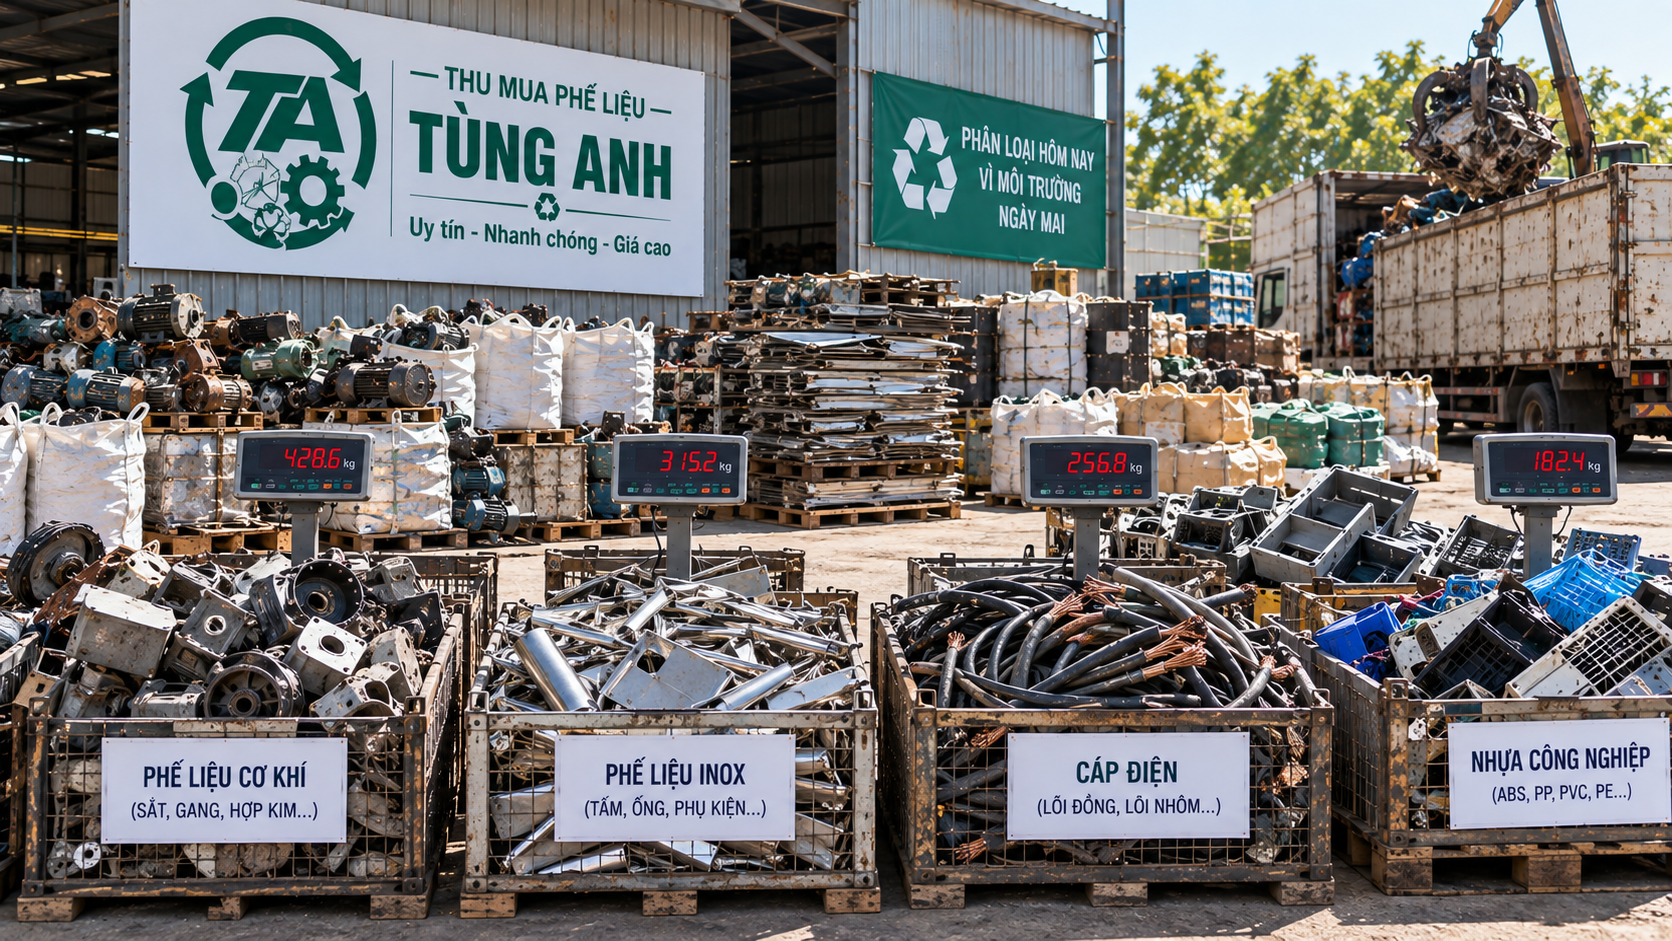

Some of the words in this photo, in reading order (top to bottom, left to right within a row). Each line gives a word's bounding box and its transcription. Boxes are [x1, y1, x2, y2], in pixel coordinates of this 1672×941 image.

[444, 66, 491, 95] THU
[499, 75, 548, 104] MUA
[556, 83, 597, 112] PHẾ
[603, 90, 645, 122] LIỆU
[217, 68, 346, 155] TA
[409, 100, 556, 187] TÙNG
[572, 134, 671, 200] ANH
[962, 126, 1000, 155] PHÂN
[1006, 135, 1034, 164] LOẠI
[1040, 139, 1067, 167] HÔM
[1072, 148, 1094, 171] NAY
[979, 163, 992, 190] VÌ
[998, 167, 1023, 195] MÔI
[1028, 174, 1080, 203] TRƯỜNG
[1000, 203, 1036, 230] NGÀY
[1041, 211, 1064, 234] MAI
[410, 216, 434, 242] Uy
[440, 219, 464, 240] tín
[485, 223, 541, 246] Nhanh
[546, 229, 597, 255] chóng
[614, 235, 639, 254] Giá
[644, 242, 671, 256] cao
[285, 448, 341, 468] 428.6
[343, 458, 356, 471] kg
[660, 451, 717, 472] 315.2
[719, 461, 732, 474] kg
[1068, 452, 1126, 473] 256.8
[1129, 462, 1143, 475] kg
[1535, 451, 1584, 471] 182.4
[1587, 461, 1601, 474] kg
[606, 756, 645, 785] PHẾ
[651, 758, 692, 790] LIỆU
[700, 763, 745, 785] INOX
[1077, 756, 1119, 783] CÁP
[1126, 756, 1177, 787] ĐIỆN
[1472, 749, 1523, 776] NHỰA
[1529, 744, 1579, 771] CÔNG
[1586, 742, 1650, 772] NGHIỆP
[144, 759, 184, 787] PHẾ
[189, 761, 231, 793] LIỆU
[239, 765, 267, 788] CƠ
[274, 761, 307, 787] KHÍ
[585, 796, 626, 819] (TẤM,
[632, 795, 669, 818] ỐNG,
[675, 800, 705, 819] PHỤ
[712, 797, 766, 819] KIỆN...)
[1155, 795, 1221, 816] NHÔM...)
[1492, 786, 1529, 805] (ABS,
[1535, 786, 1555, 802] PP,
[1560, 784, 1591, 801] PVC,
[1596, 782, 1631, 801] PE...)
[176, 802, 224, 821] GANG,
[230, 801, 263, 821] HỢP
[269, 802, 317, 821] KIM...)
